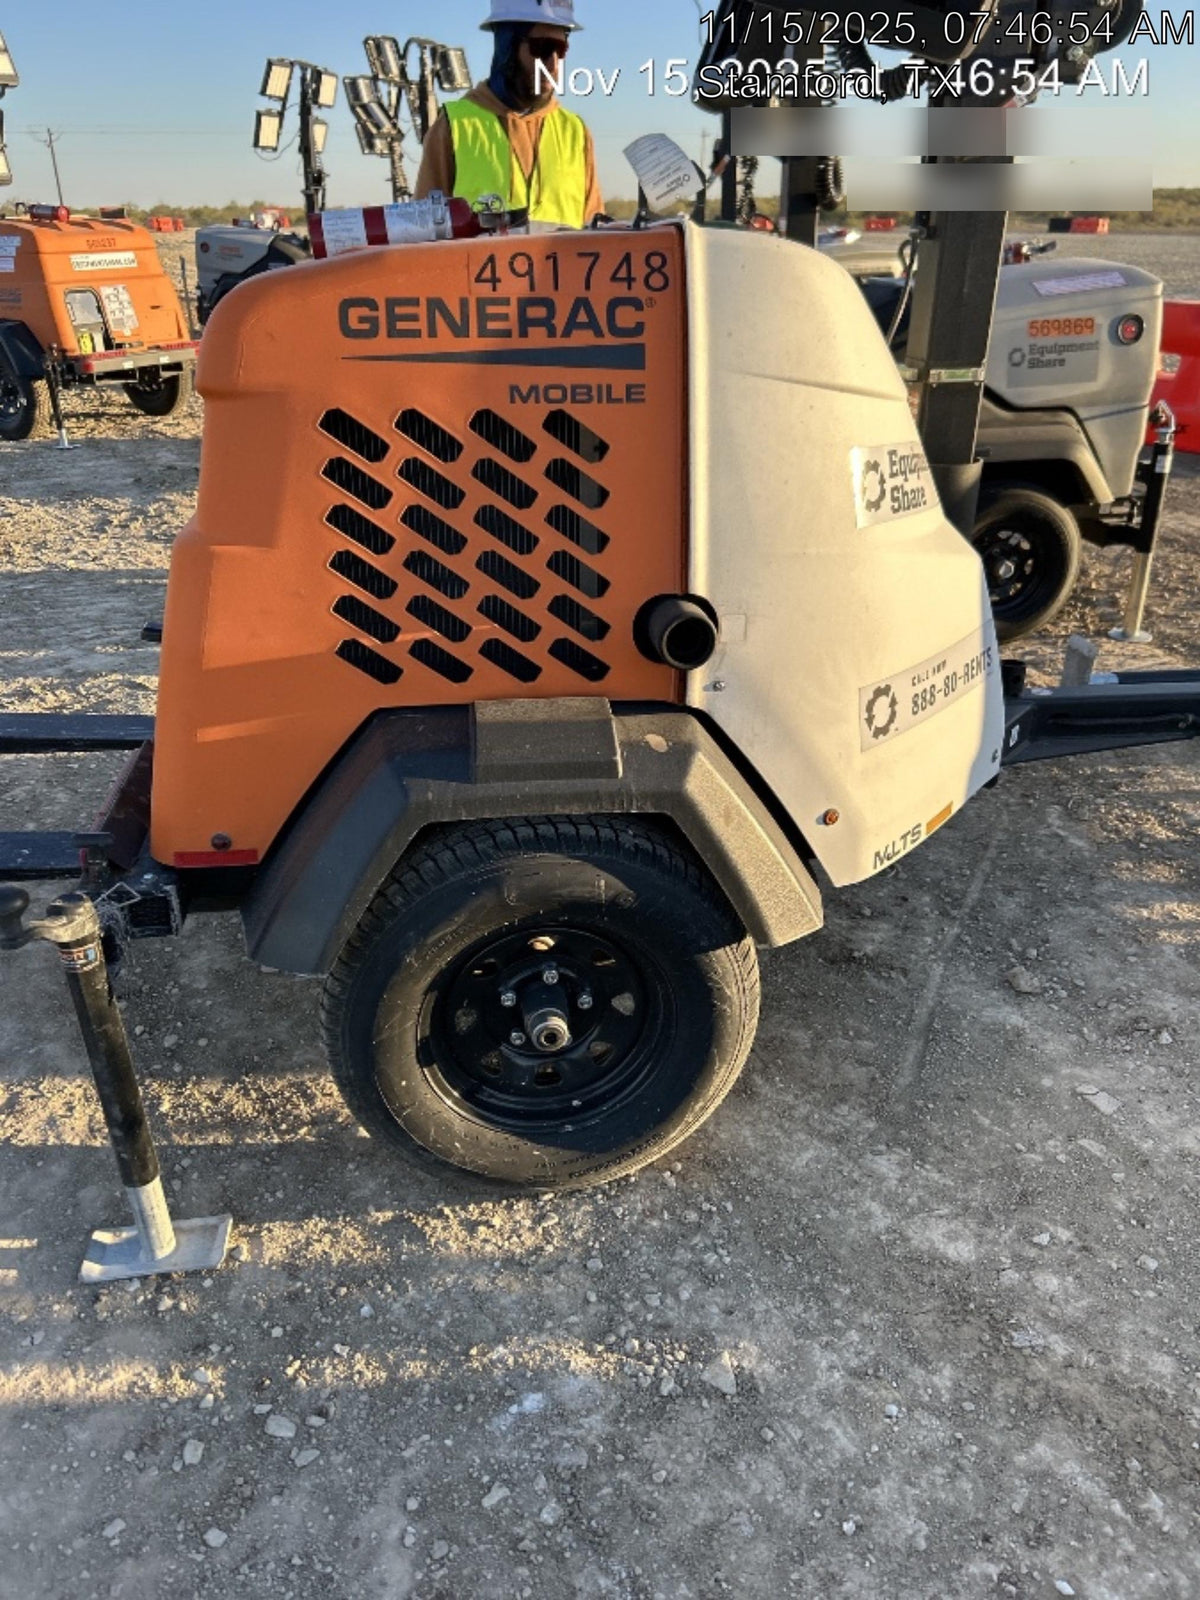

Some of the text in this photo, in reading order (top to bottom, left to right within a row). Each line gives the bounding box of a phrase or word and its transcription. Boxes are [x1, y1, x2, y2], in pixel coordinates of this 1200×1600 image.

[474, 252, 670, 292] 491748
[338, 296, 646, 339] GENERAC
[1028, 317, 1095, 338] 569869
[1028, 339, 1099, 357] Equipment
[1027, 356, 1066, 370] Share
[509, 383, 646, 404] MOBILE
[890, 484, 928, 514] Share
[911, 646, 993, 716] 888-80-RENTS
